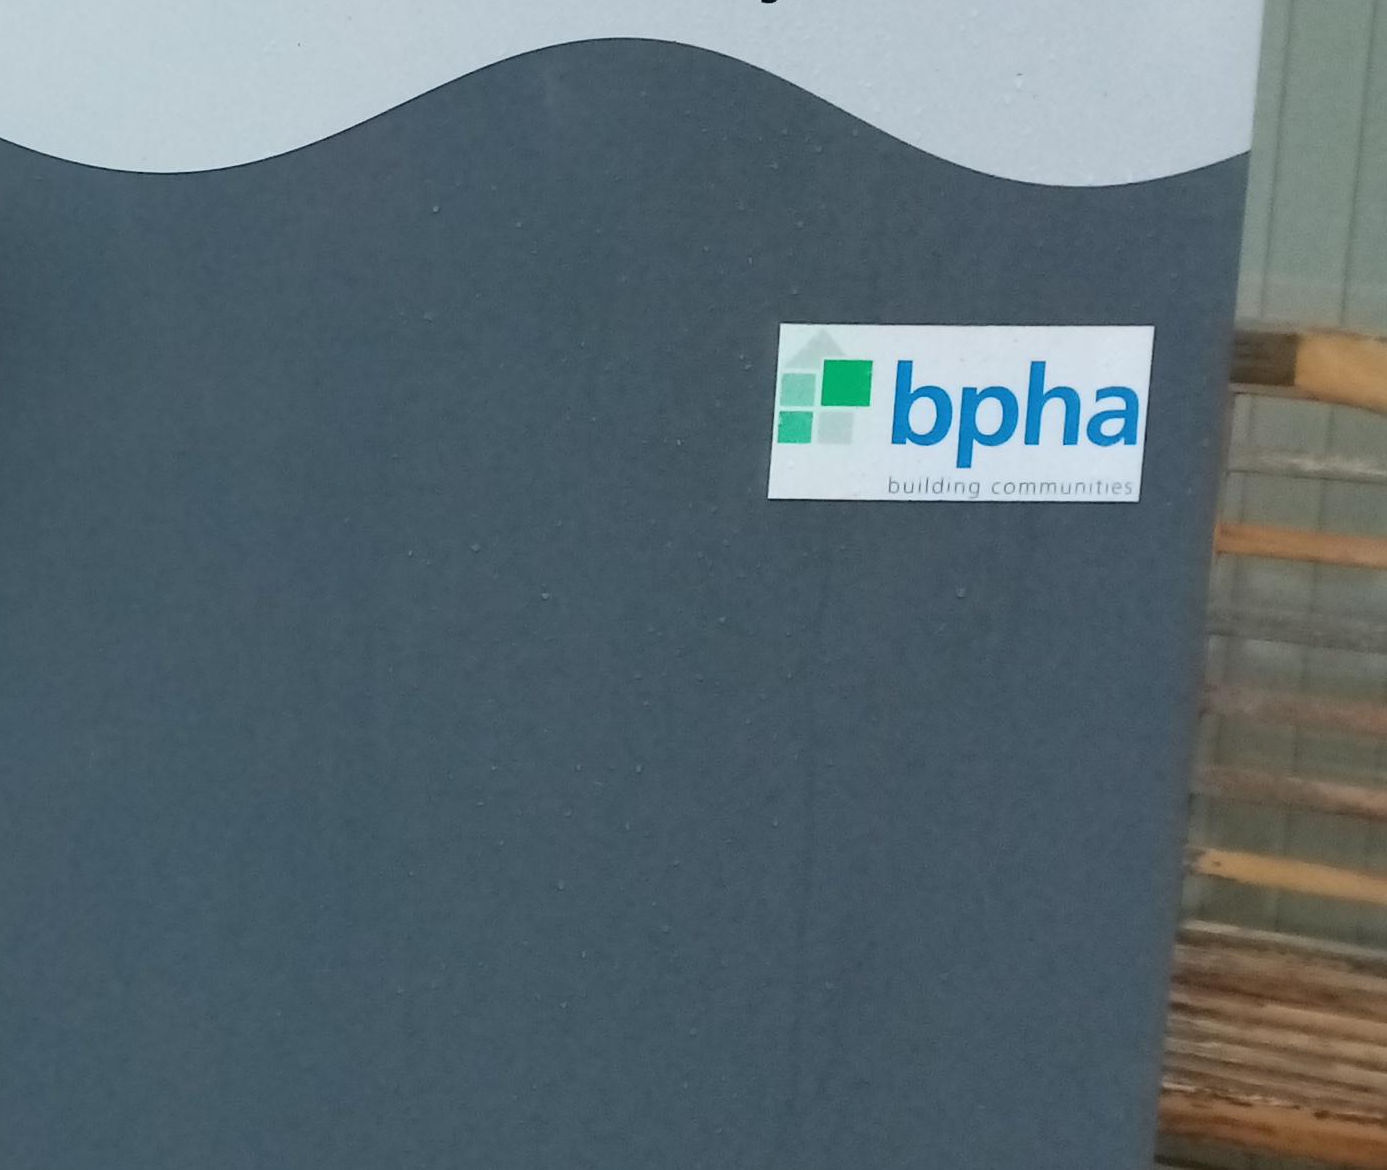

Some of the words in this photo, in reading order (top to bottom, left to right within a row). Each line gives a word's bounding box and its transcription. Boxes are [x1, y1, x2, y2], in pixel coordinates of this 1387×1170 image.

[891, 360, 1140, 468] bpha
[887, 476, 982, 499] building
[990, 478, 1133, 496] communities
